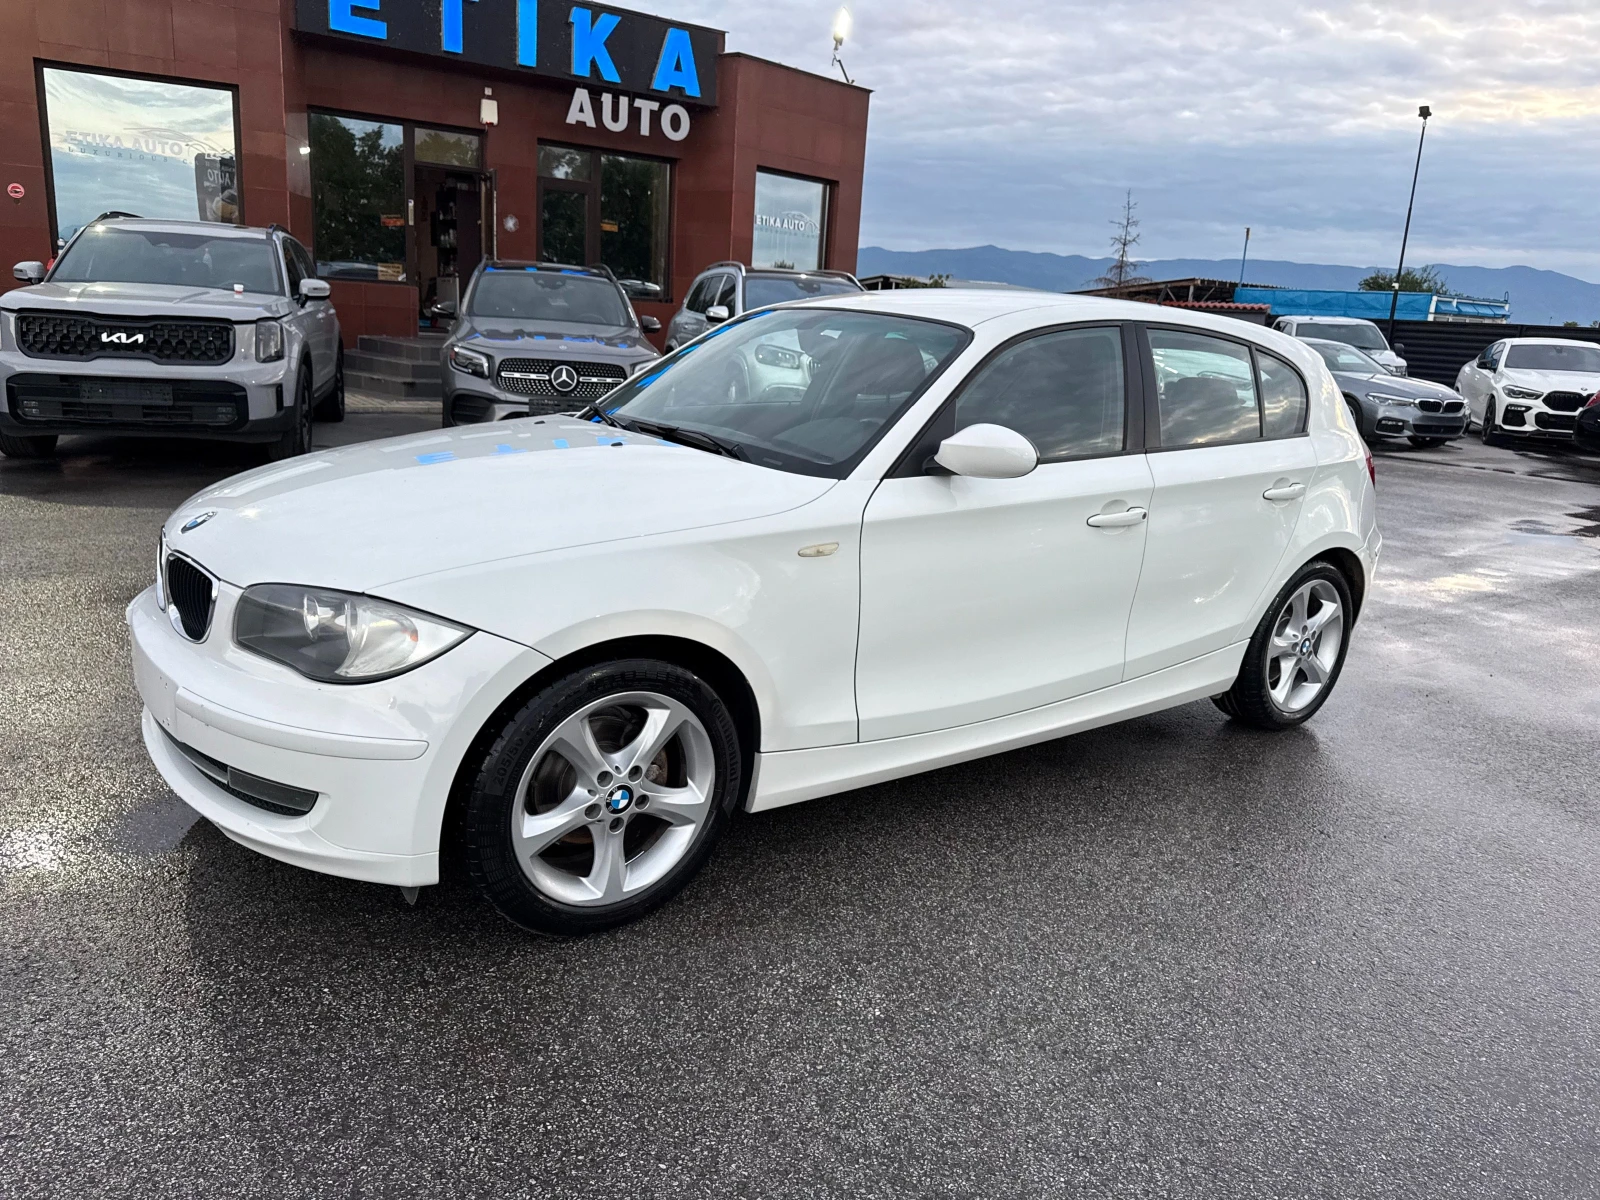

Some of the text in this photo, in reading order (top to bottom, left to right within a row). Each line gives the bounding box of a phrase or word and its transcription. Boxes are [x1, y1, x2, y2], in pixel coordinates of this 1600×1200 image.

[565, 87, 691, 142] AUTO
[65, 130, 183, 156] ETIKA AUTO
[68, 146, 168, 163] LUXURIOUS
[756, 214, 805, 231] ETIKA AUTO
